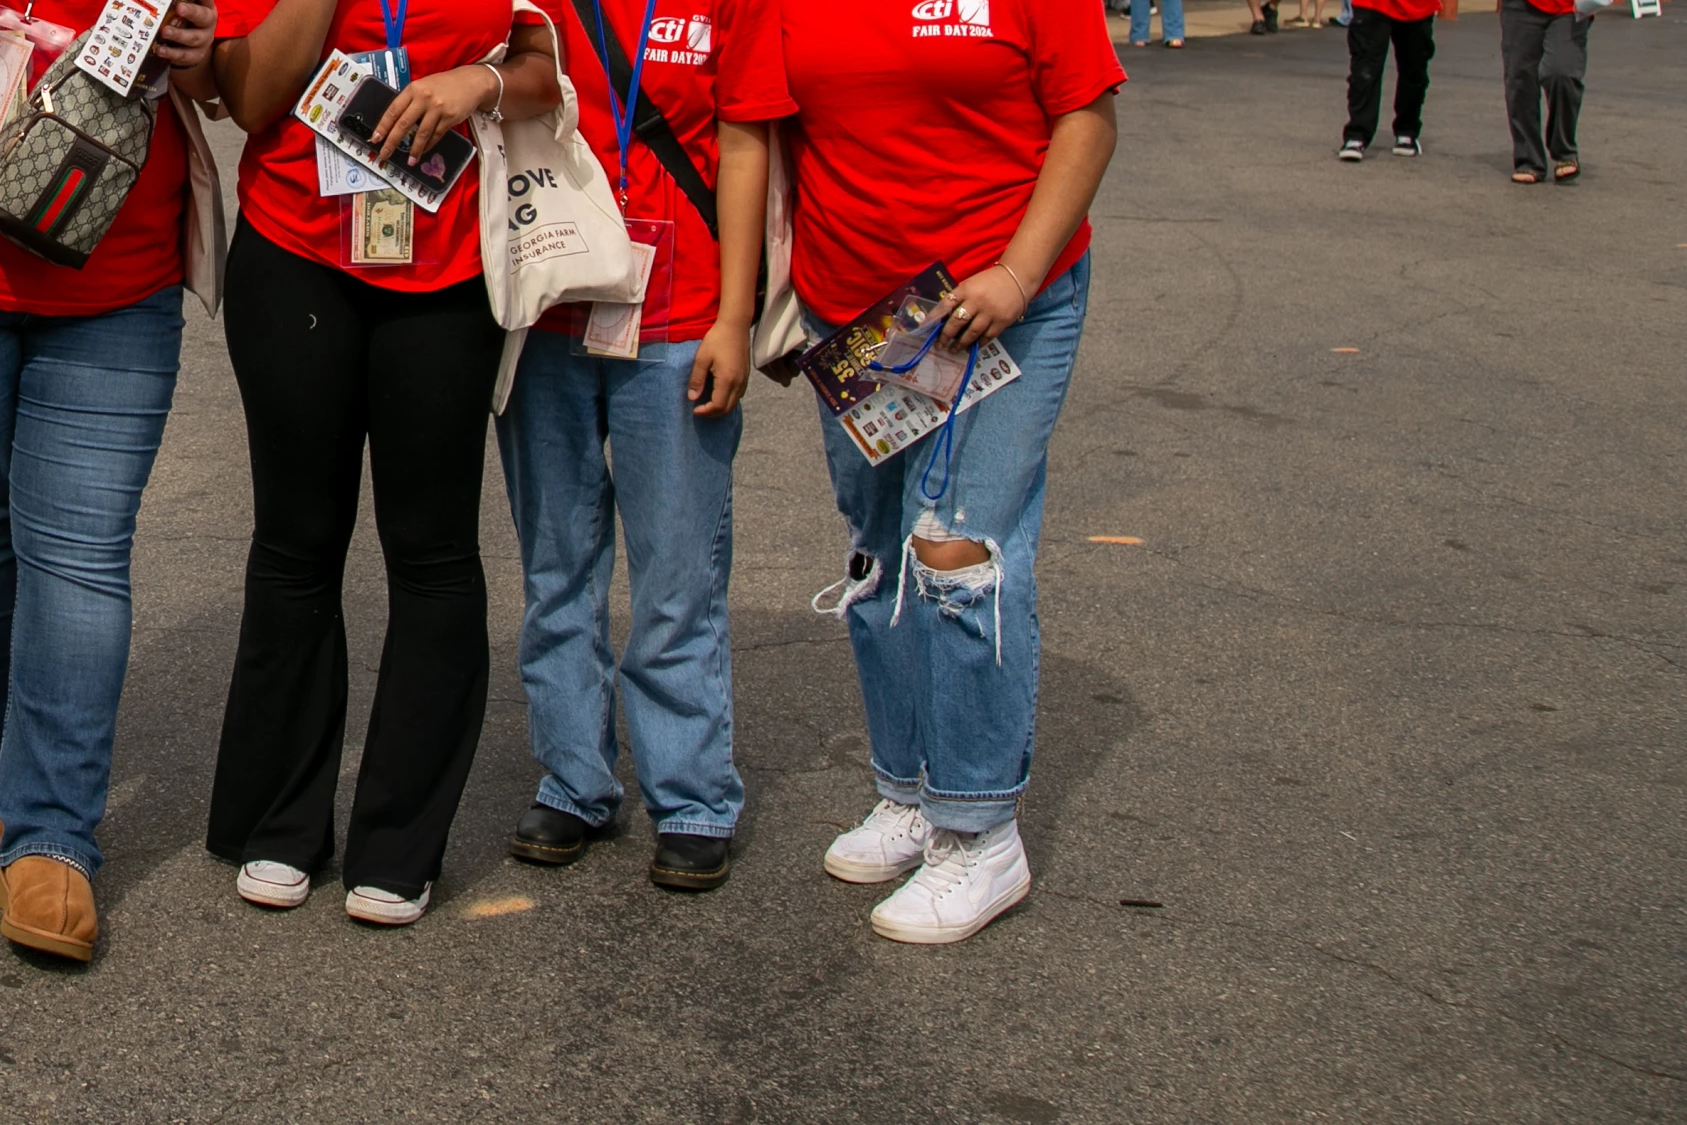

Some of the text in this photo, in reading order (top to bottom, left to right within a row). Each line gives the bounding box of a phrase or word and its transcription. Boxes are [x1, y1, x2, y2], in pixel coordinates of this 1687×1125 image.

[650, 18, 686, 42] cti
[912, 24, 995, 38] FAIR DAY 2024
[643, 47, 669, 63] FAIR
[670, 50, 693, 65] DAY
[508, 168, 558, 198] OVE
[510, 228, 576, 255] GEORGIA FARM
[512, 240, 566, 266] INSURANCE
[830, 357, 856, 384] 35
